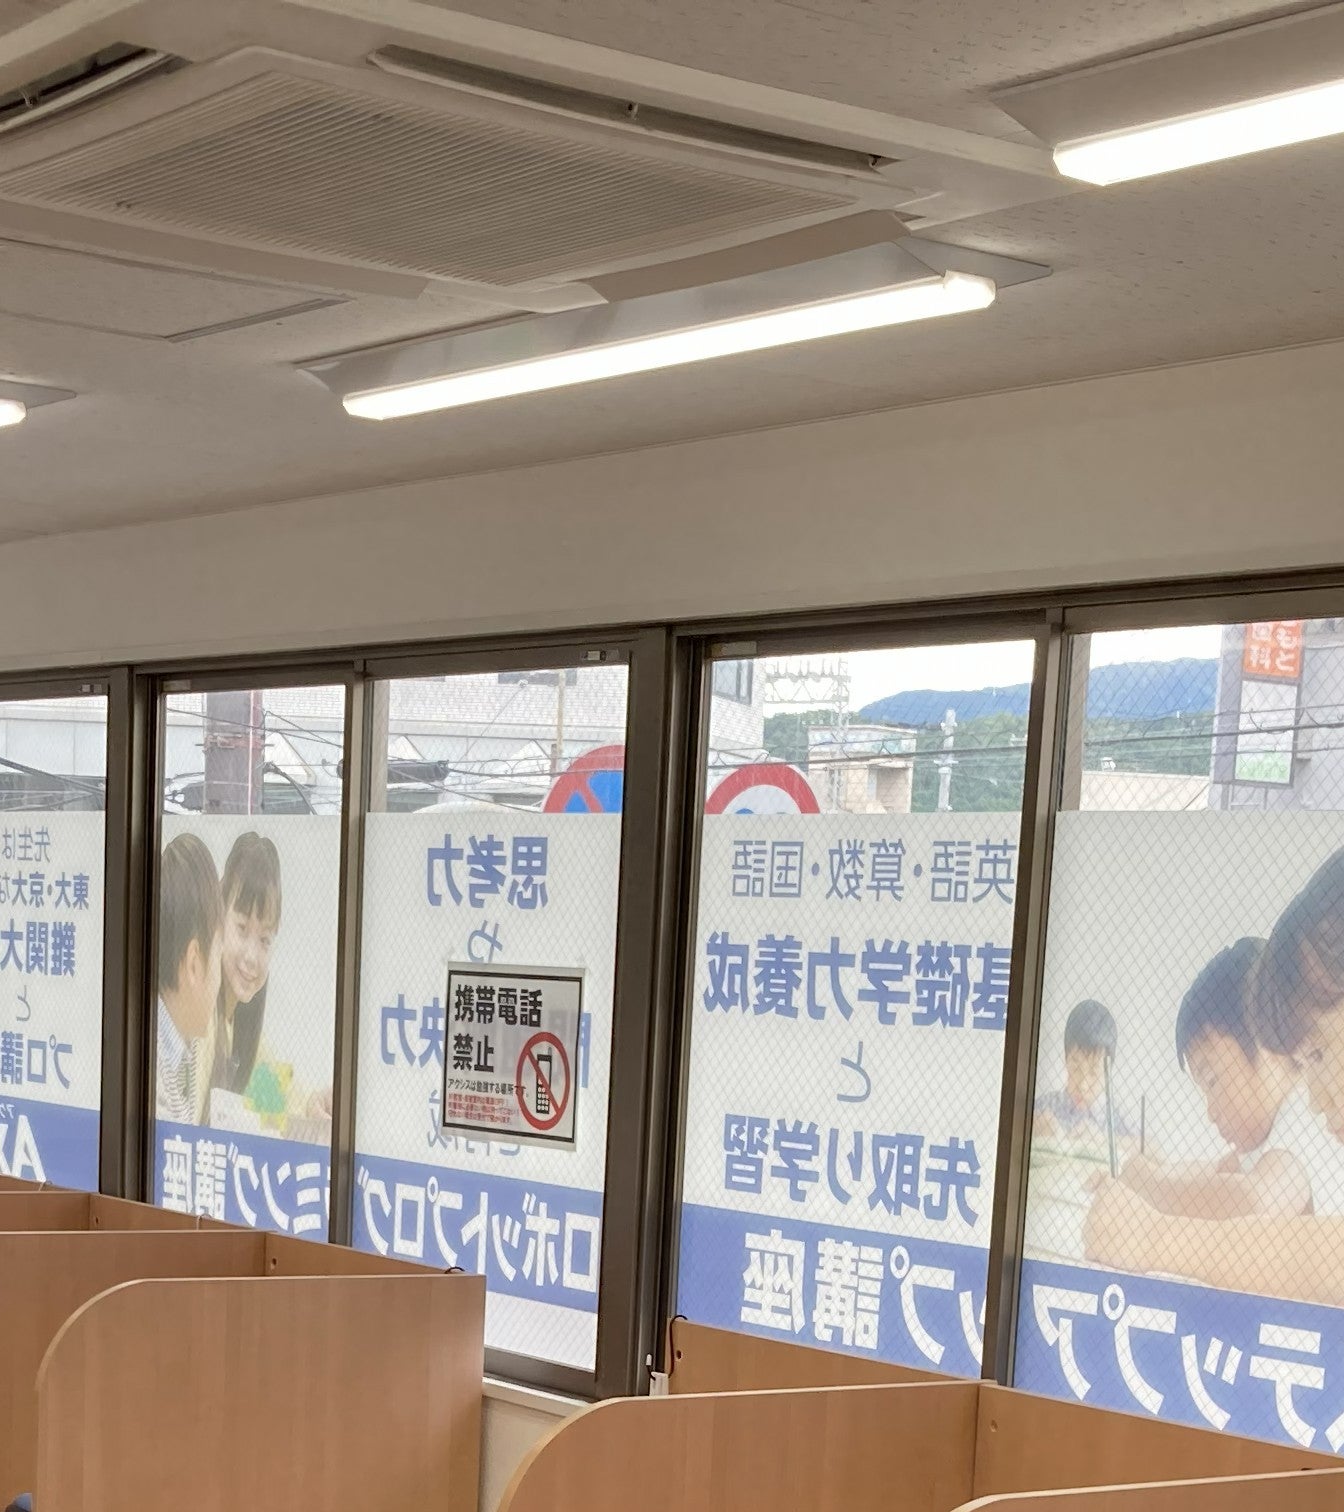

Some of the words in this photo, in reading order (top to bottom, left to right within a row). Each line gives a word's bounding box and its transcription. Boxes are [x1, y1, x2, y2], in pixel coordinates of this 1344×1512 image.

[454, 984, 542, 1028] 携帯電話
[453, 1032, 495, 1073] 禁止
